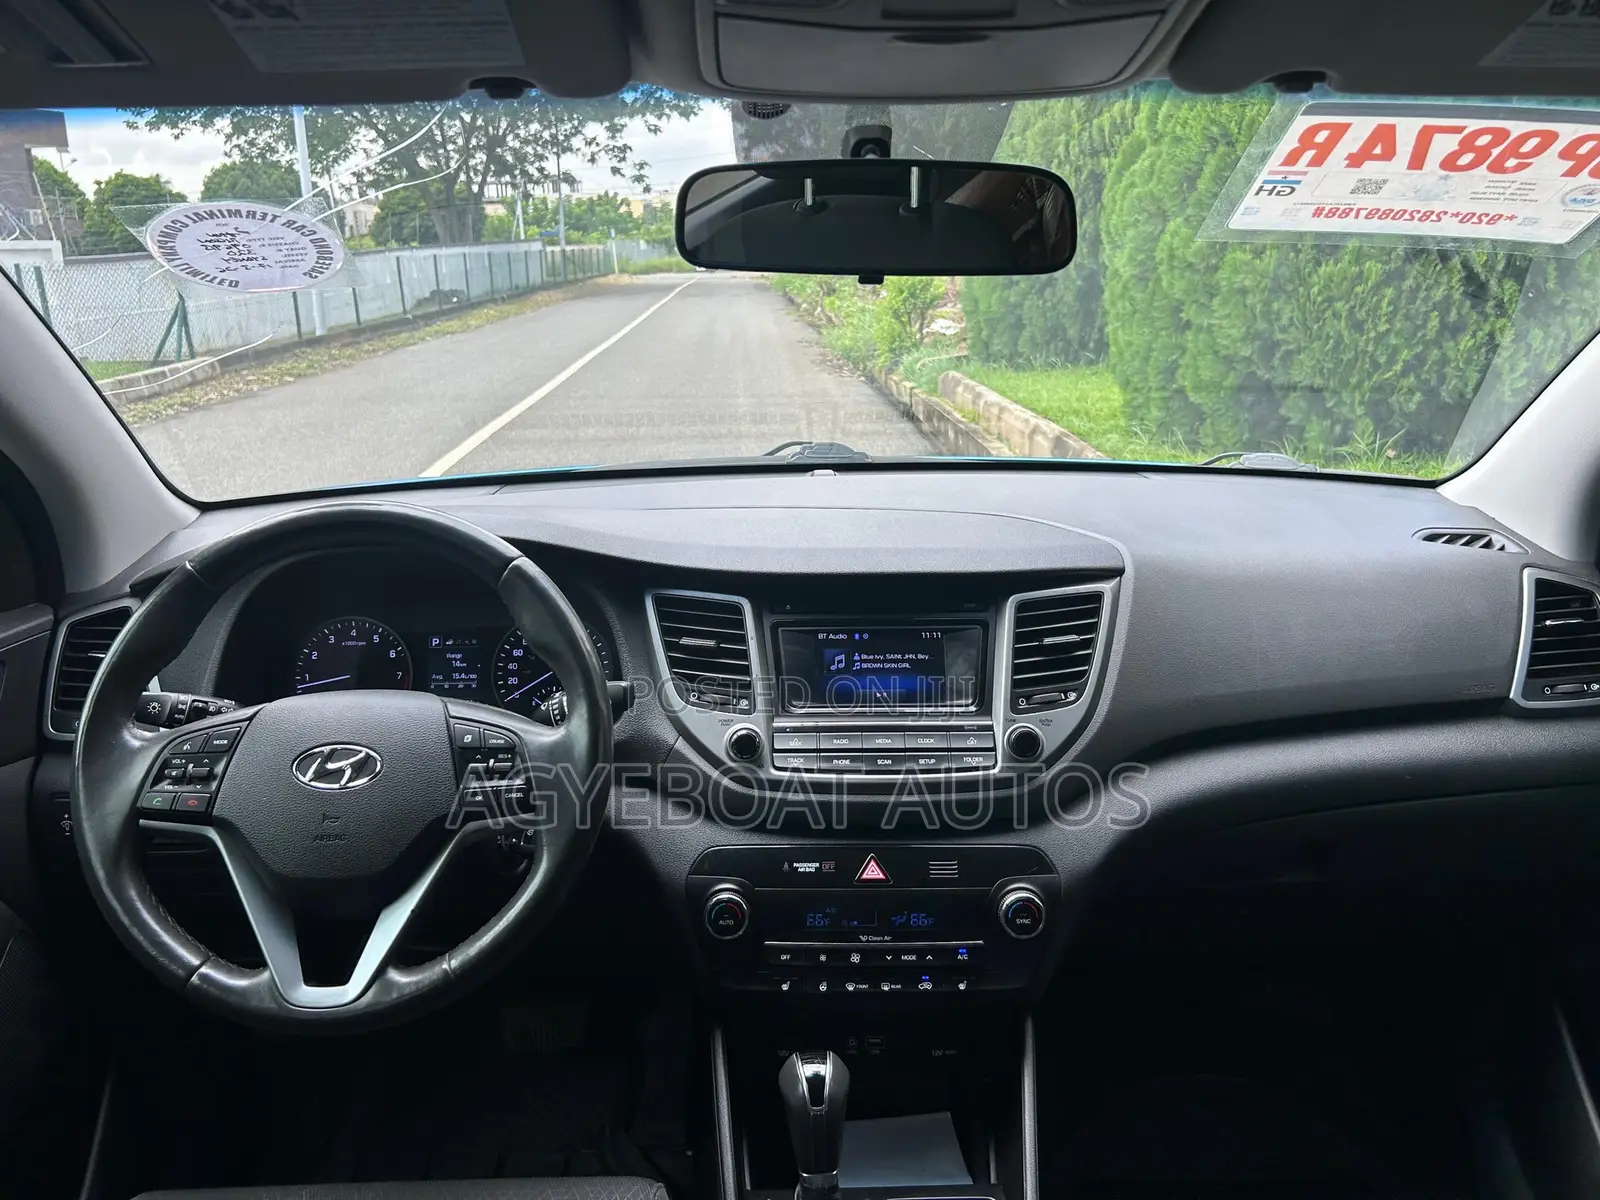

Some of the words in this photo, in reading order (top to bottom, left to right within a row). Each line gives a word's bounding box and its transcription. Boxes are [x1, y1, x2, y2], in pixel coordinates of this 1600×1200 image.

[350, 629, 357, 637] 4
[818, 632, 828, 640] BT
[828, 632, 848, 640] Audio
[921, 631, 942, 639] 11:11
[328, 635, 335, 643] 3
[373, 634, 379, 643] 5
[432, 637, 440, 647] P
[312, 651, 319, 660] 2
[389, 649, 396, 658] 6
[512, 649, 524, 657] 60
[507, 662, 518, 671] 40
[304, 673, 309, 681] 1
[396, 671, 403, 680] 7
[507, 676, 519, 685] 20
[314, 833, 348, 842] AIRBAG
[931, 1049, 944, 1057] 12V
